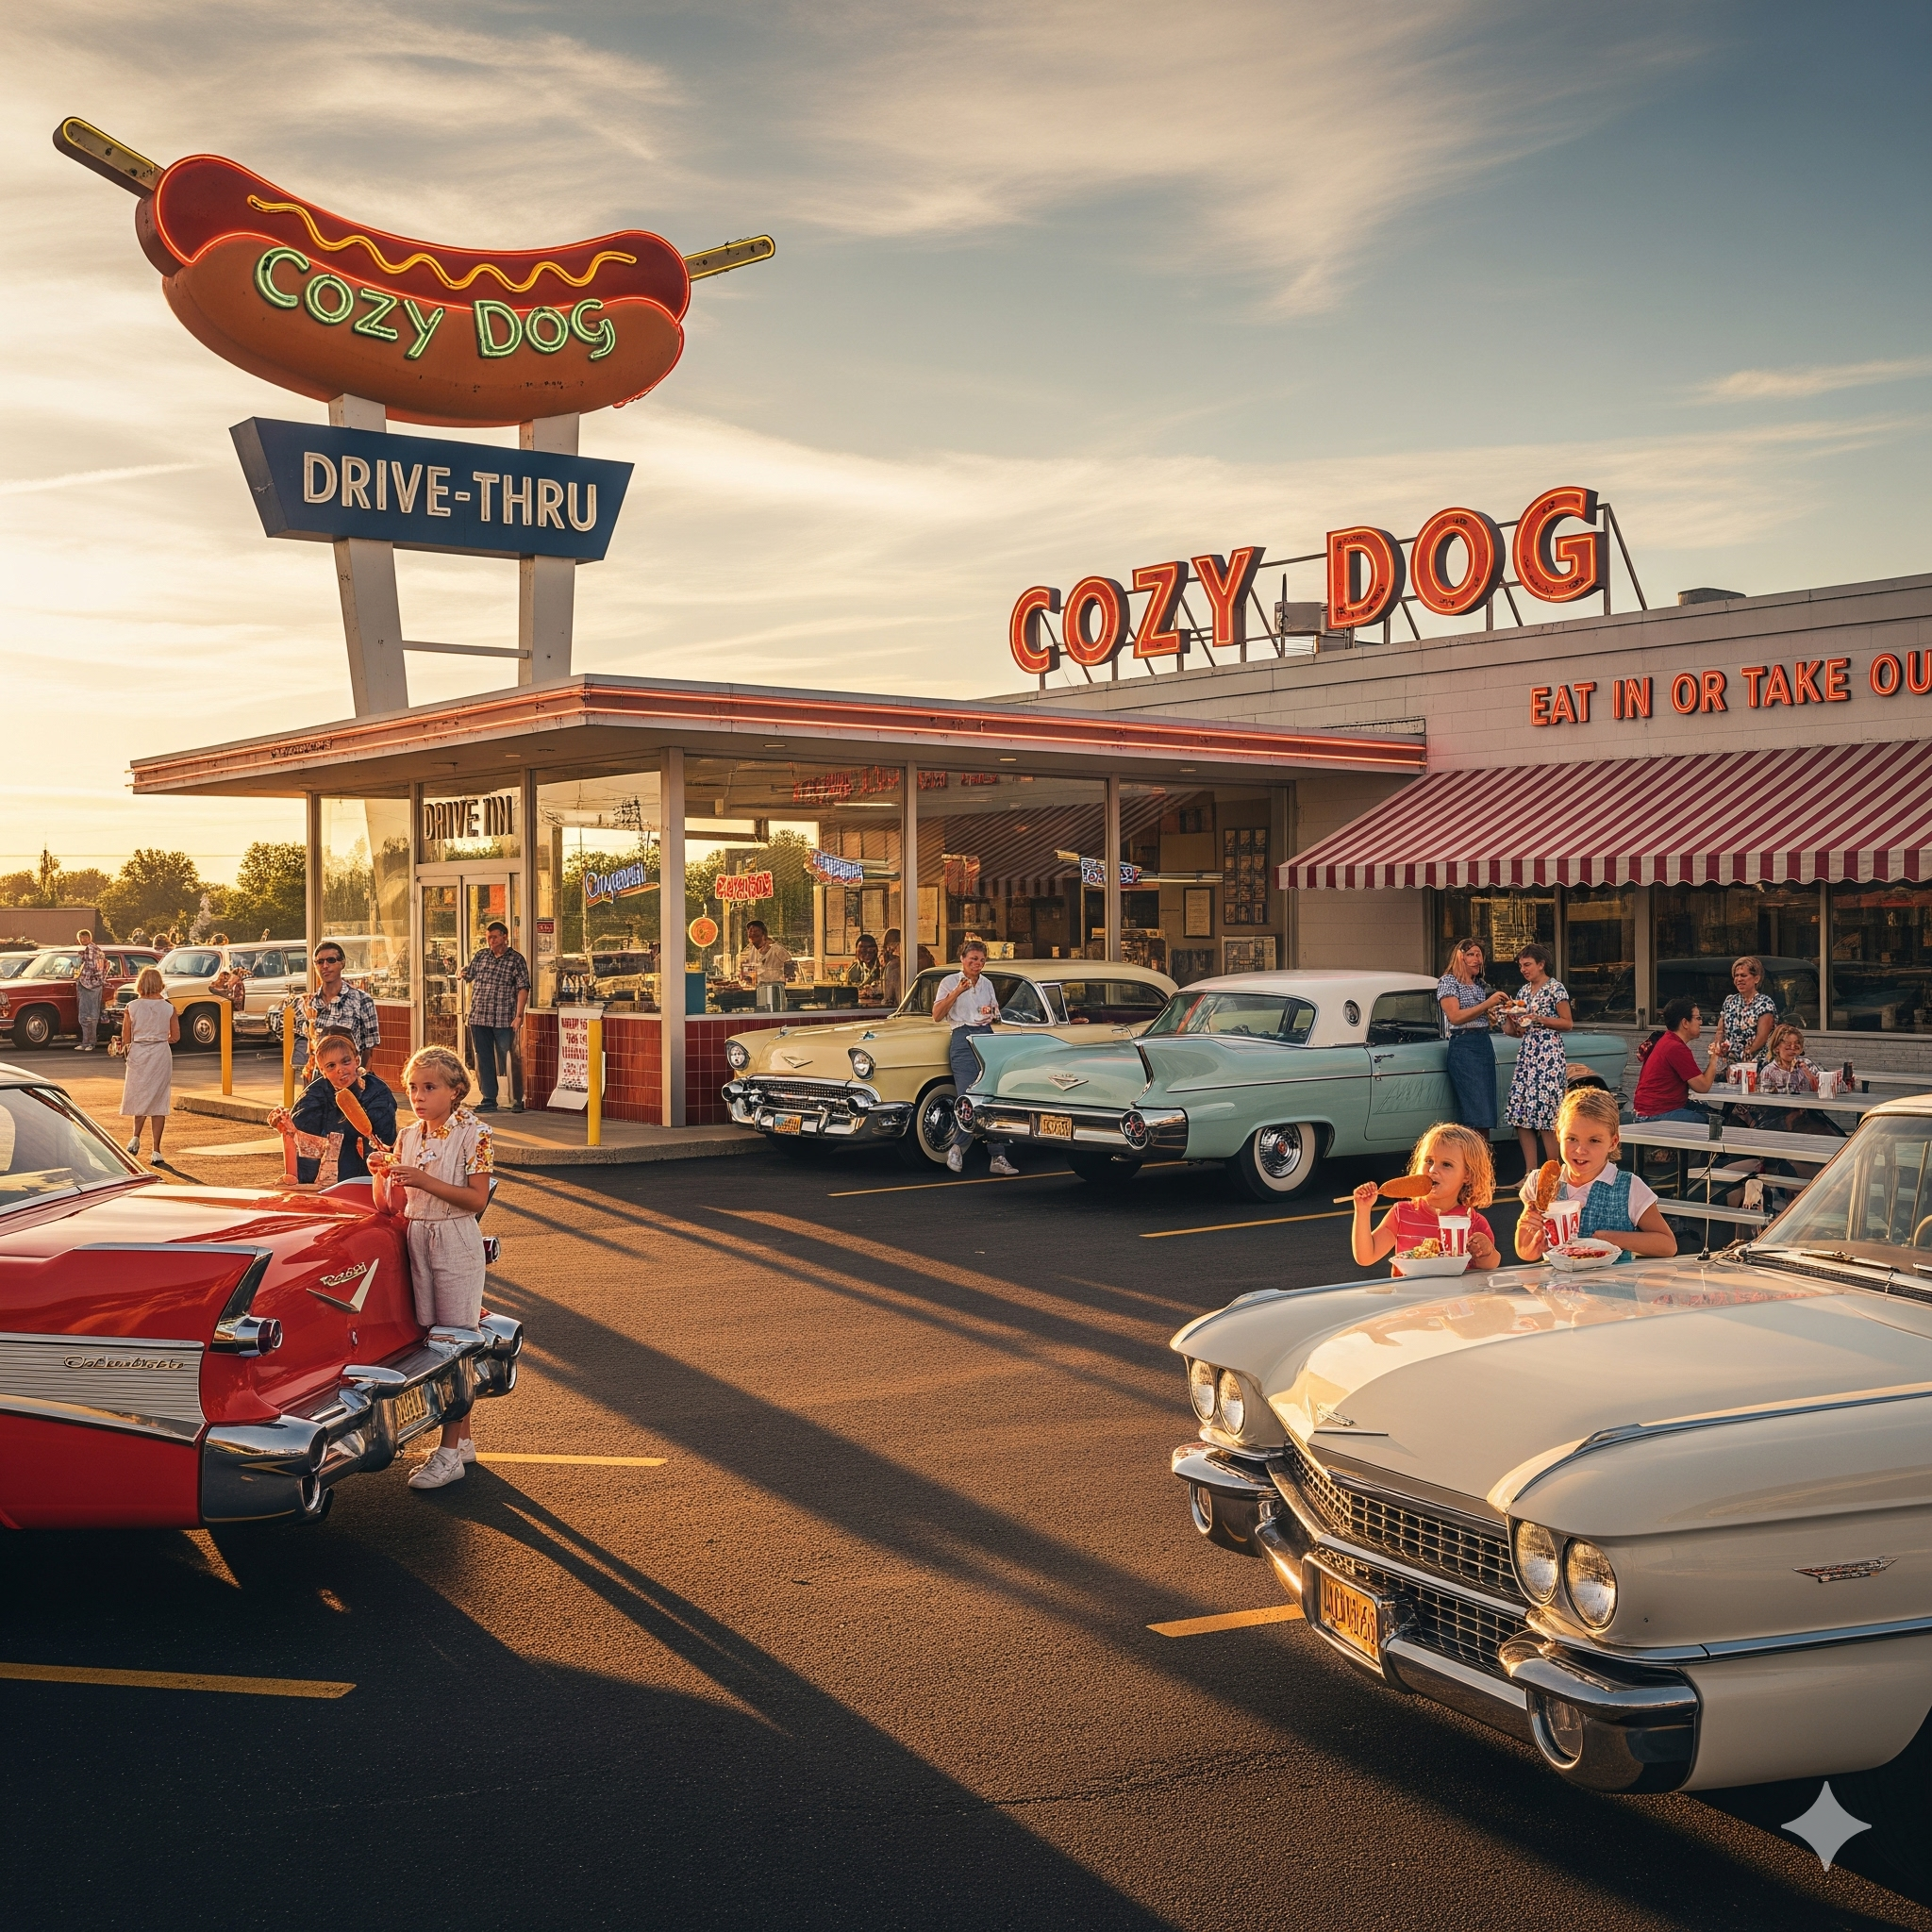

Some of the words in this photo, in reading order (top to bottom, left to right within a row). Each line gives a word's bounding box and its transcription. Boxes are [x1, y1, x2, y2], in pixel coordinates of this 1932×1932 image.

[303, 451, 598, 533] DRIVE-THRU
[1009, 545, 1266, 675] COZY
[1326, 486, 1605, 630] DOG
[1530, 681, 1596, 726] EAT
[1612, 676, 1653, 721] IN
[1671, 670, 1727, 715] OR
[1740, 657, 1851, 708] TAKE
